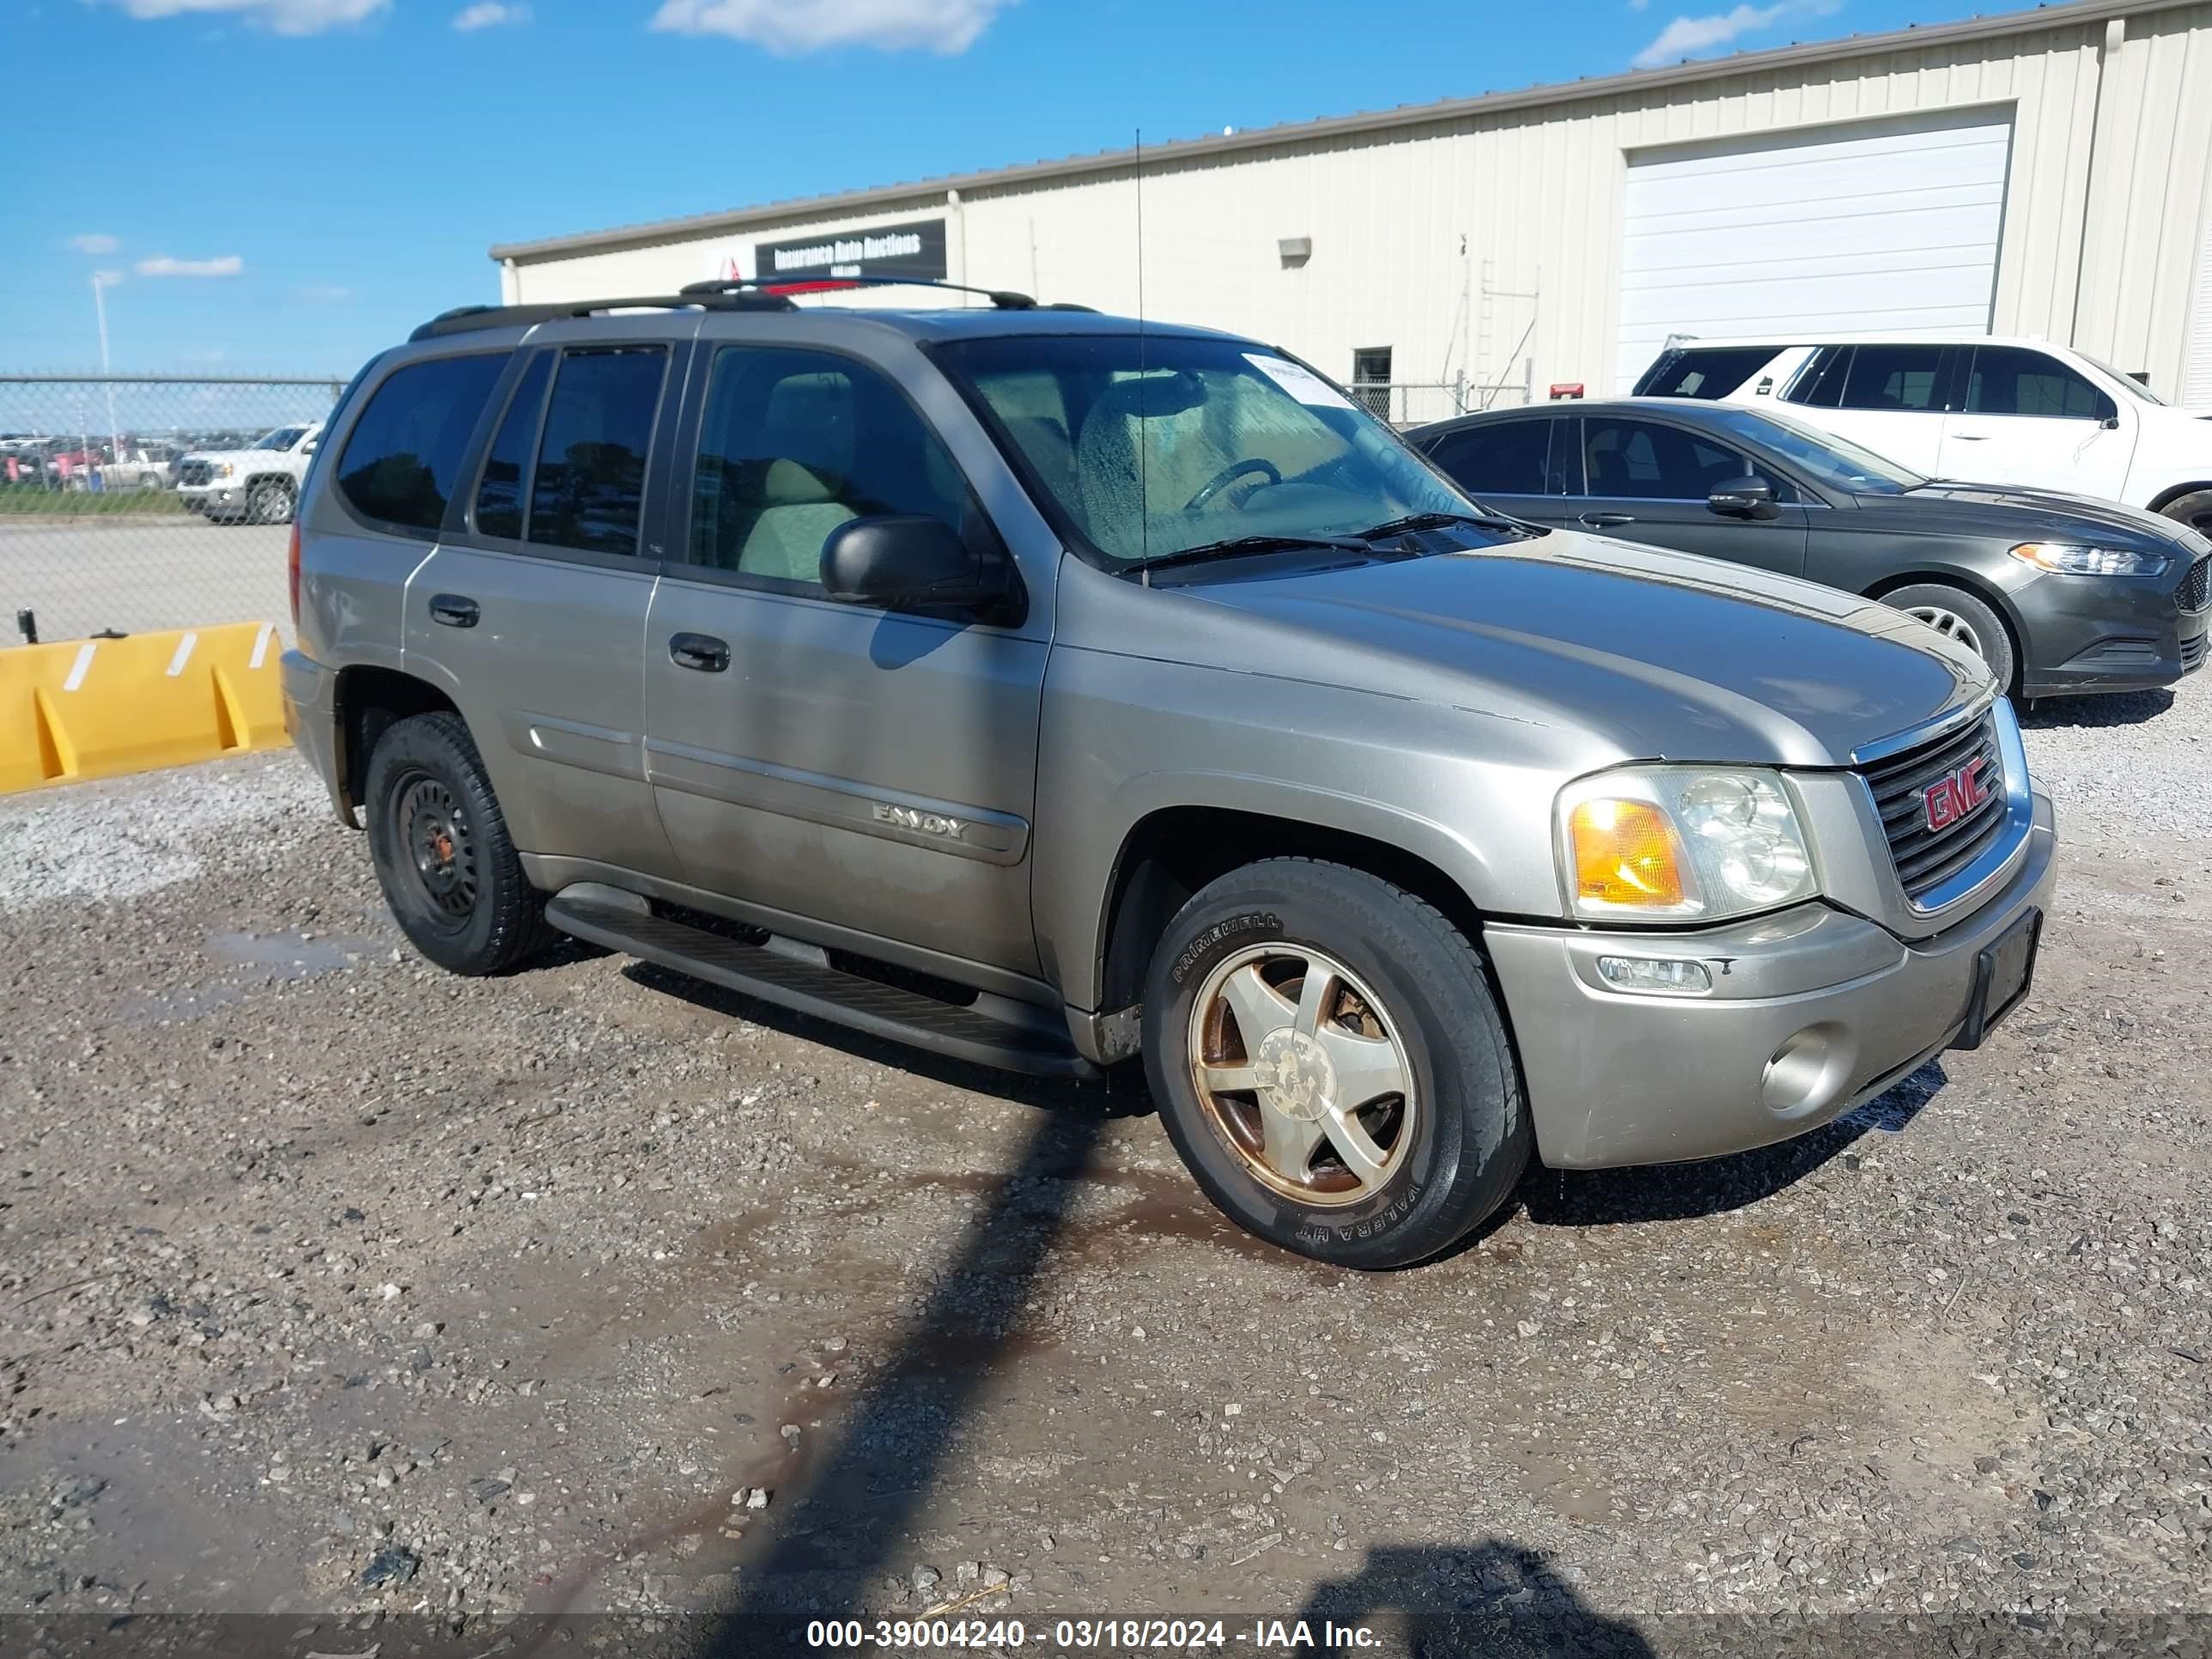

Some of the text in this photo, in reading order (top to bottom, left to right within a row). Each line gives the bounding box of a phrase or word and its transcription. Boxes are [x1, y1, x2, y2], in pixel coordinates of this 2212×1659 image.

[872, 802, 969, 839] ENVOY
[1923, 756, 1989, 833] GMC
[1338, 1182, 1421, 1243] VALERA
